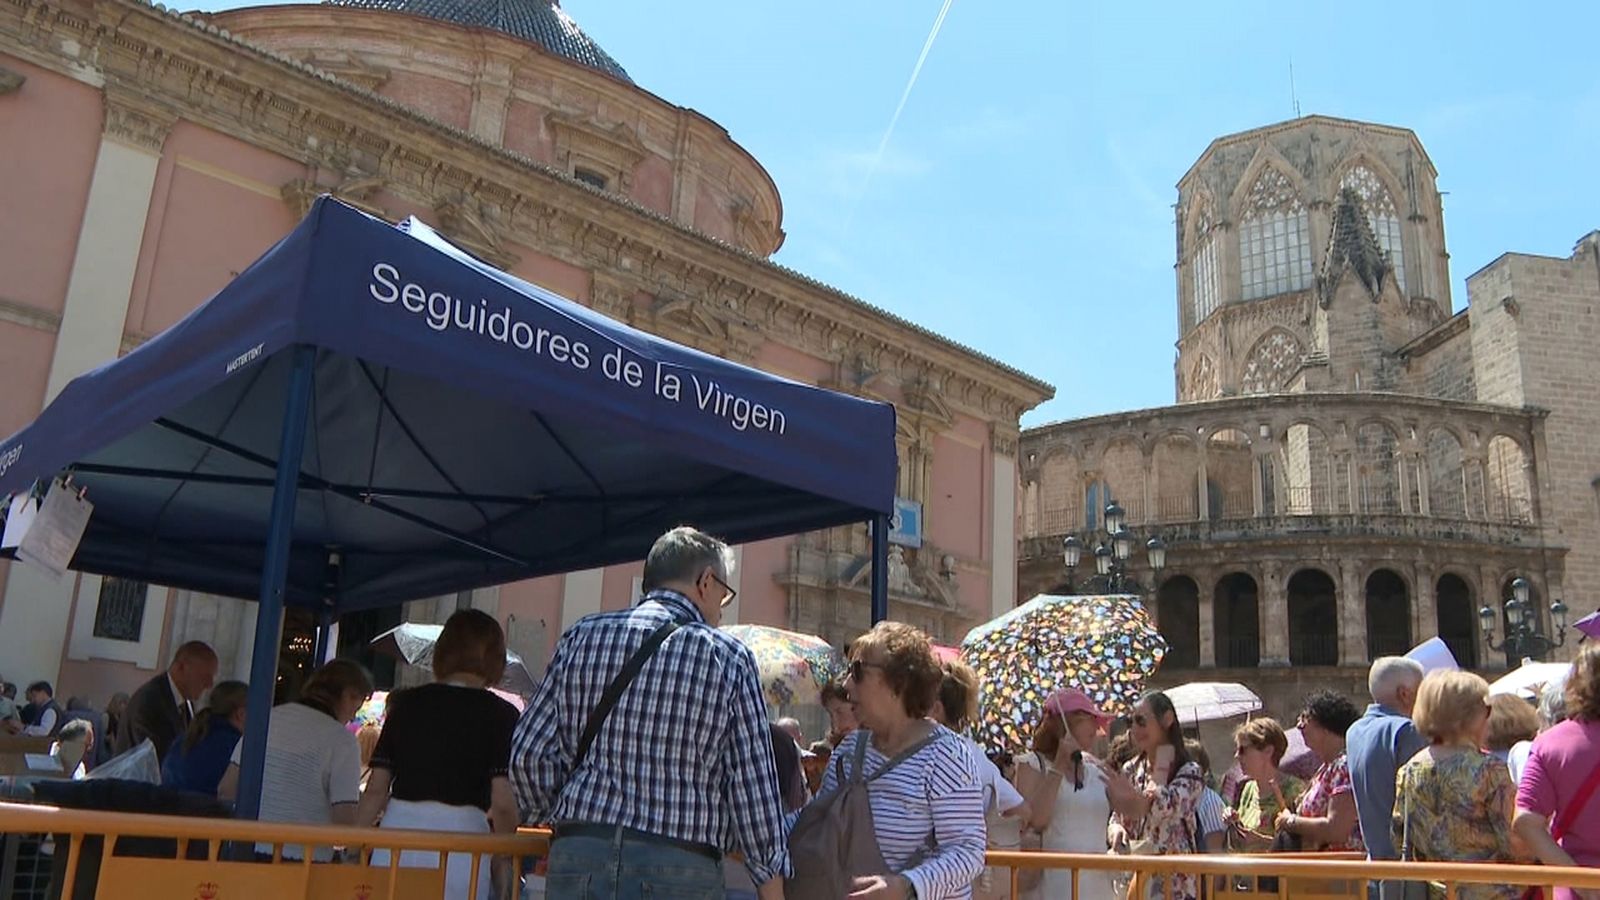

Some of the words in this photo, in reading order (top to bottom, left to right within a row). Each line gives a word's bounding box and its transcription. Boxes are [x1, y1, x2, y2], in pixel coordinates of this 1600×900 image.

[369, 263, 590, 369] Seguidores
[603, 347, 643, 387] de
[655, 361, 681, 402] la
[691, 375, 786, 436] Virgen
